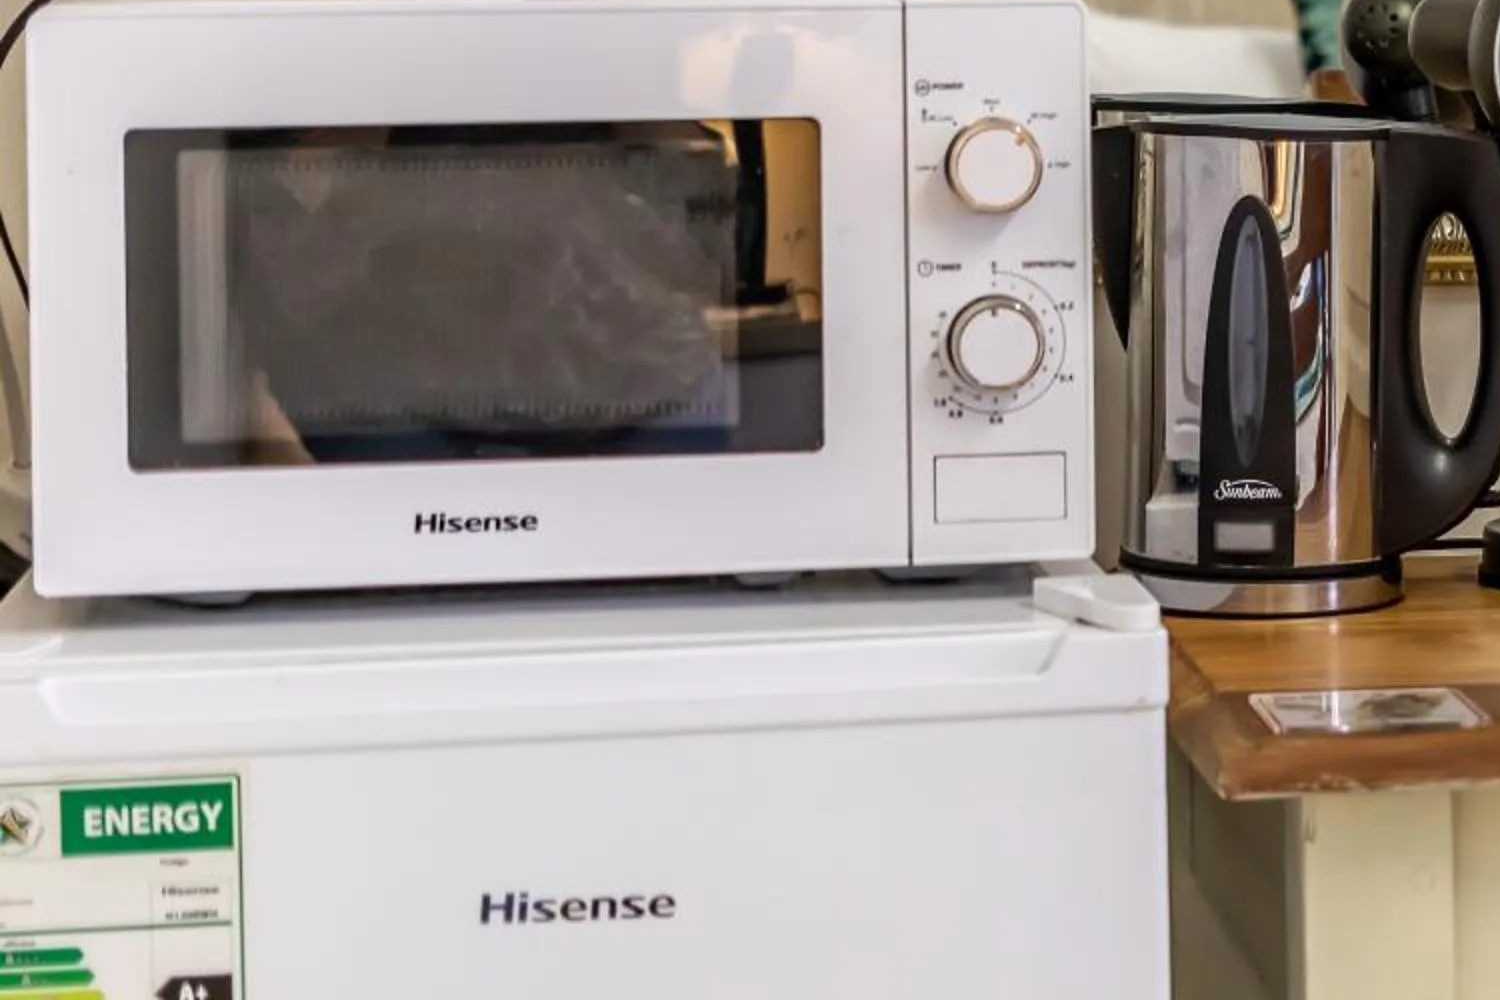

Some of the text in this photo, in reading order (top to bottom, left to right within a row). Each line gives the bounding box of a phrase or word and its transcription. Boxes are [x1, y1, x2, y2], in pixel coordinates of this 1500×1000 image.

[1213, 479, 1283, 500] Sunbeam
[414, 512, 539, 534] Hisense
[83, 800, 223, 839] ENERGY
[480, 892, 676, 925] Hisense
